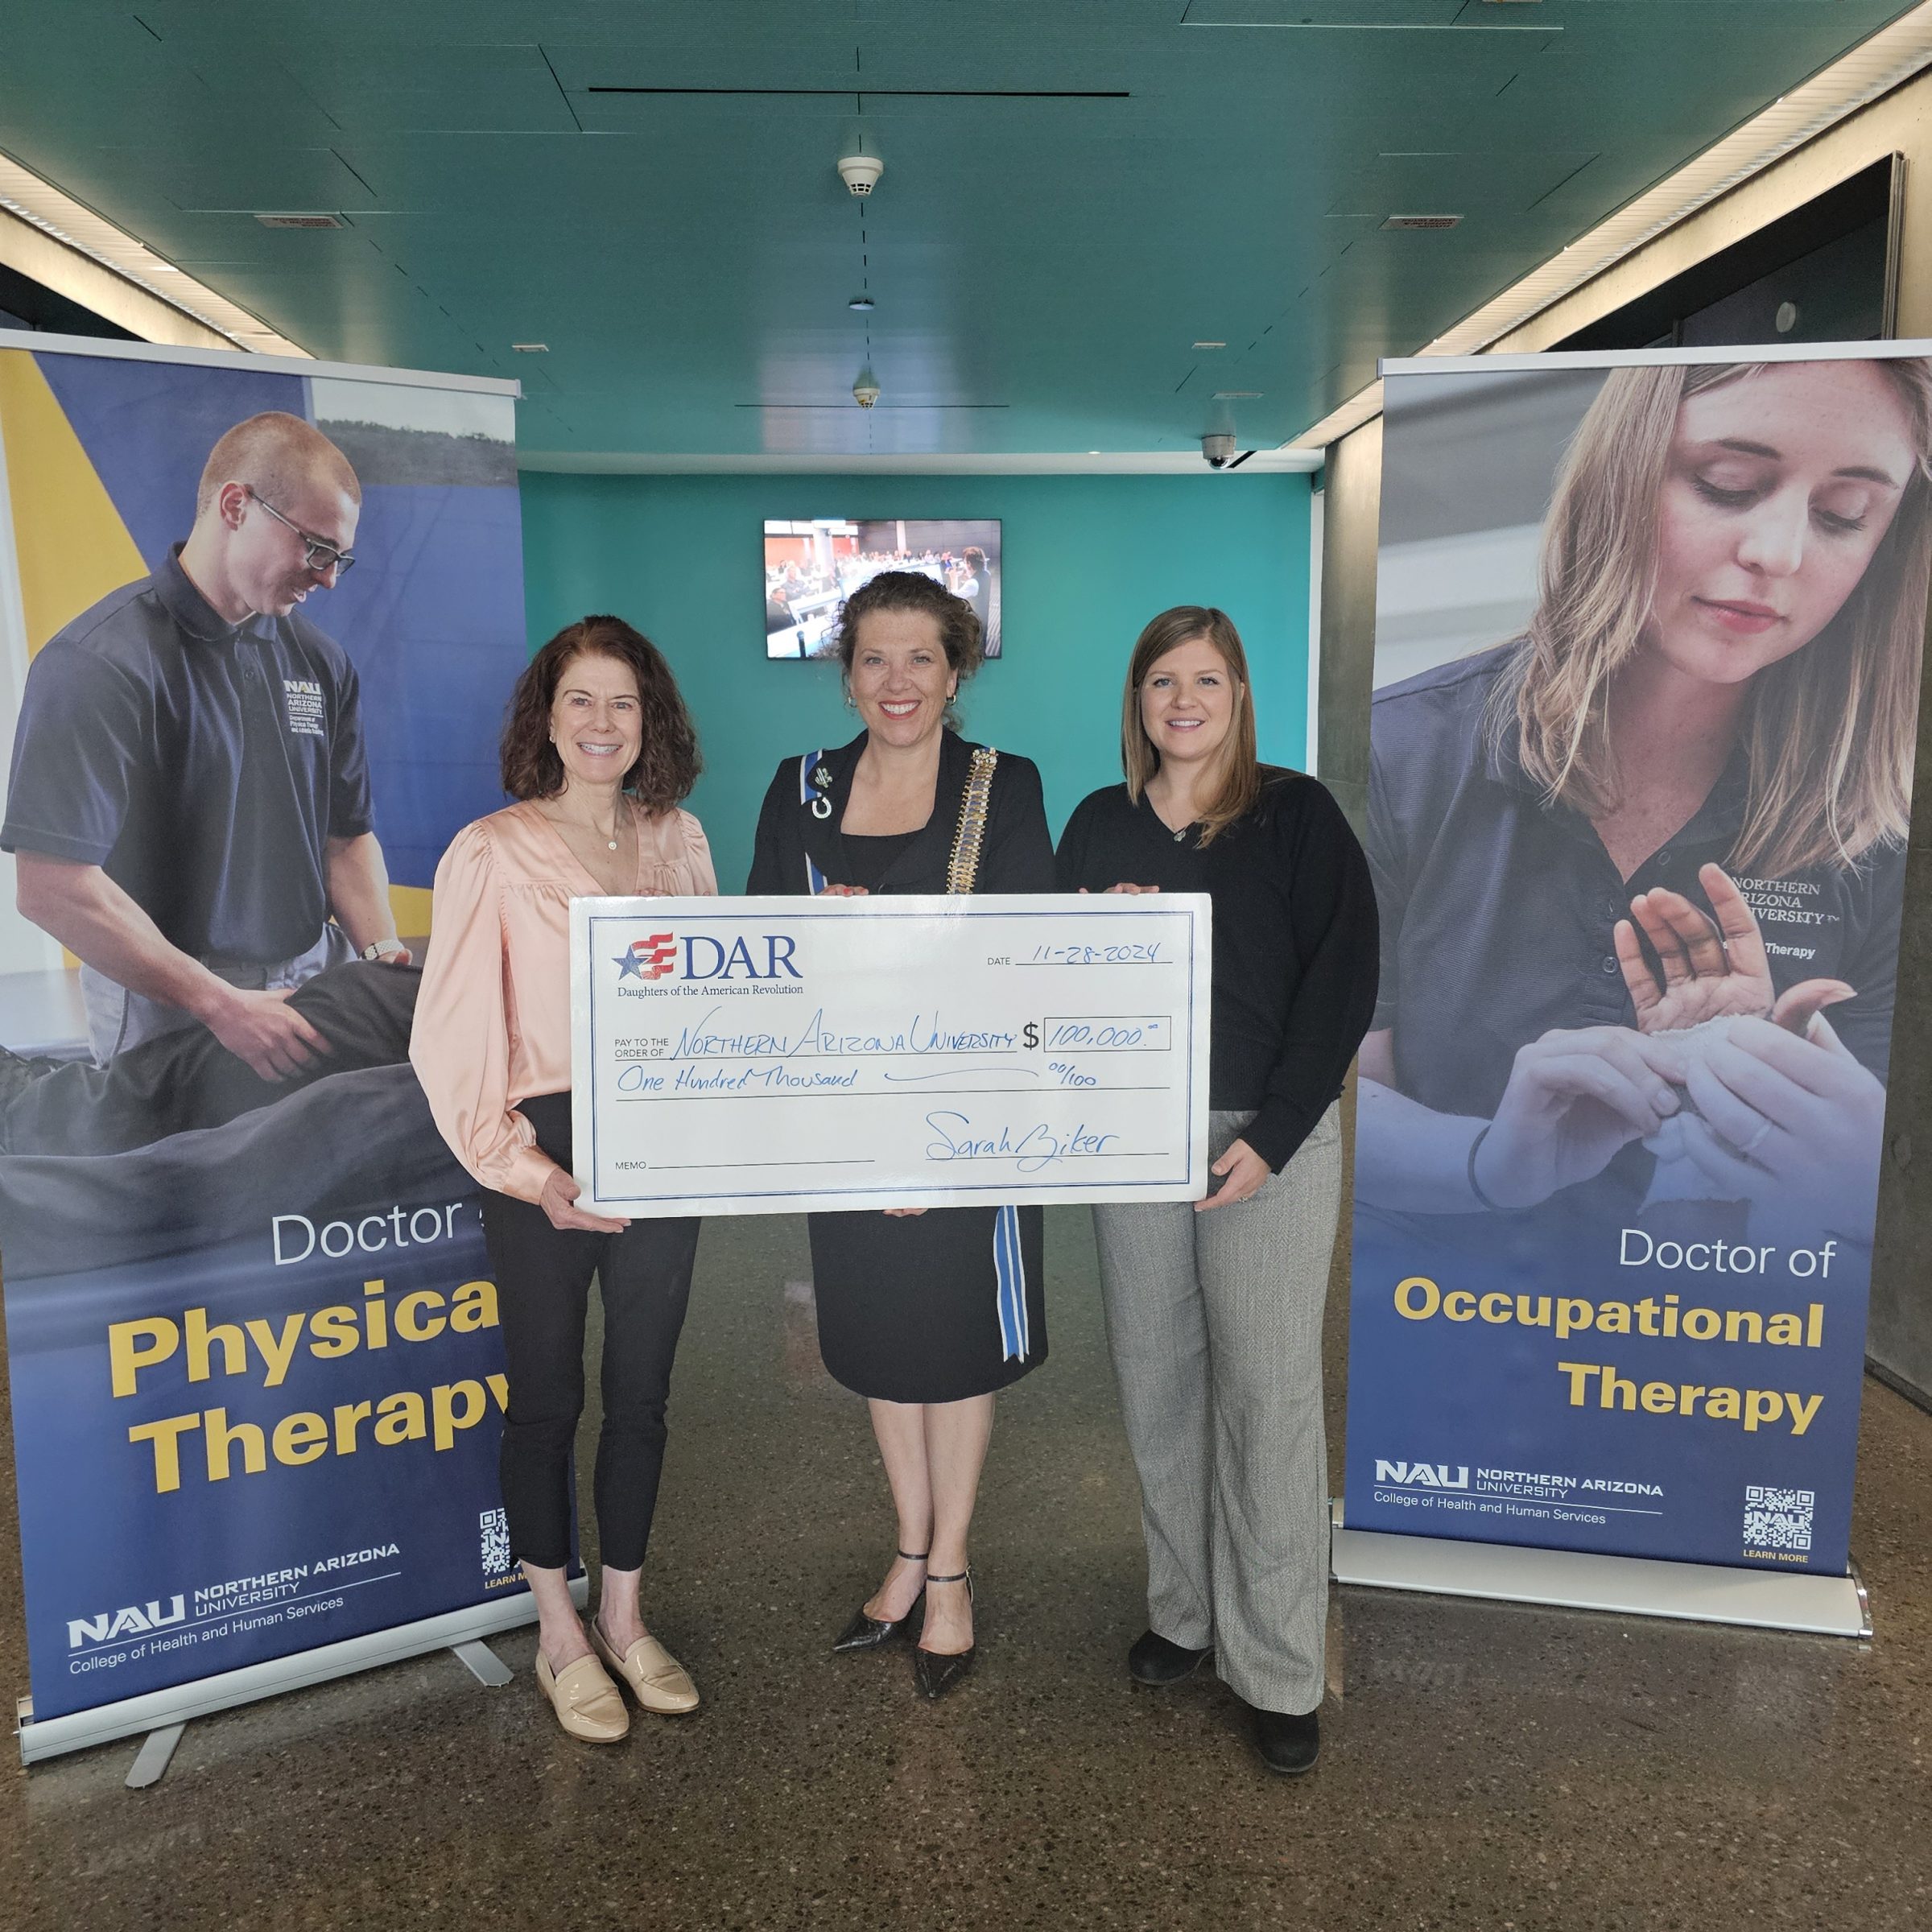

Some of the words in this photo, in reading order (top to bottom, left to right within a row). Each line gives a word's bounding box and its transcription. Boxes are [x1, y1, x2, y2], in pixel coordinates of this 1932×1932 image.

[283, 680, 321, 695] NAU
[287, 693, 322, 701] NORTHERN
[288, 699, 322, 708] ARIZONA
[1740, 892, 1802, 908] RIZONA
[680, 936, 803, 980] DAR
[1033, 942, 1161, 964] 11-28-2024
[1765, 943, 1816, 960] Therapy
[617, 987, 668, 999] Daughters
[671, 986, 681, 996] of
[683, 986, 700, 996] the
[701, 985, 749, 996] American
[752, 985, 803, 995] Revolution
[615, 1038, 634, 1046] PAY
[635, 1038, 648, 1046] TO
[650, 1038, 669, 1046] THE
[1023, 1022, 1039, 1051] $
[615, 1049, 647, 1058] ORDER
[650, 1048, 665, 1057] OF
[617, 1065, 663, 1091] One
[675, 1065, 753, 1091] Hundred
[758, 1065, 857, 1088] Thousand
[926, 1111, 1011, 1160] Sarah
[615, 1161, 647, 1170] MEMO
[272, 1202, 463, 1265] Doctor
[1620, 1228, 1776, 1274] Doctor
[1788, 1240, 1837, 1278] of
[1393, 1277, 1824, 1348] Occupational
[109, 1279, 500, 1397] Physica
[1558, 1361, 1824, 1435] Therapy
[1374, 1459, 1468, 1488] NAU
[1477, 1468, 1577, 1488] NORTHERN
[1581, 1478, 1664, 1496] ARIZONA
[1476, 1480, 1569, 1499] UNIVERSITY
[1374, 1491, 1418, 1507] College
[1421, 1496, 1434, 1507] of
[1438, 1496, 1476, 1511] Health
[1480, 1501, 1502, 1514] and
[1506, 1504, 1550, 1519] Human
[1554, 1509, 1606, 1525] Services
[1743, 1549, 1776, 1560] LEARN
[1778, 1553, 1809, 1563] MORE
[195, 1565, 308, 1603] NORTHERN
[313, 1542, 400, 1575] ARIZONA
[485, 1574, 515, 1589] LEARN
[196, 1581, 300, 1616] UNIVERSITY
[66, 1594, 186, 1649] NAU
[69, 1651, 126, 1674] College
[130, 1643, 146, 1658] of
[151, 1633, 198, 1654] Health
[202, 1622, 228, 1641] and
[232, 1612, 283, 1634] Human
[286, 1596, 344, 1620] Services
